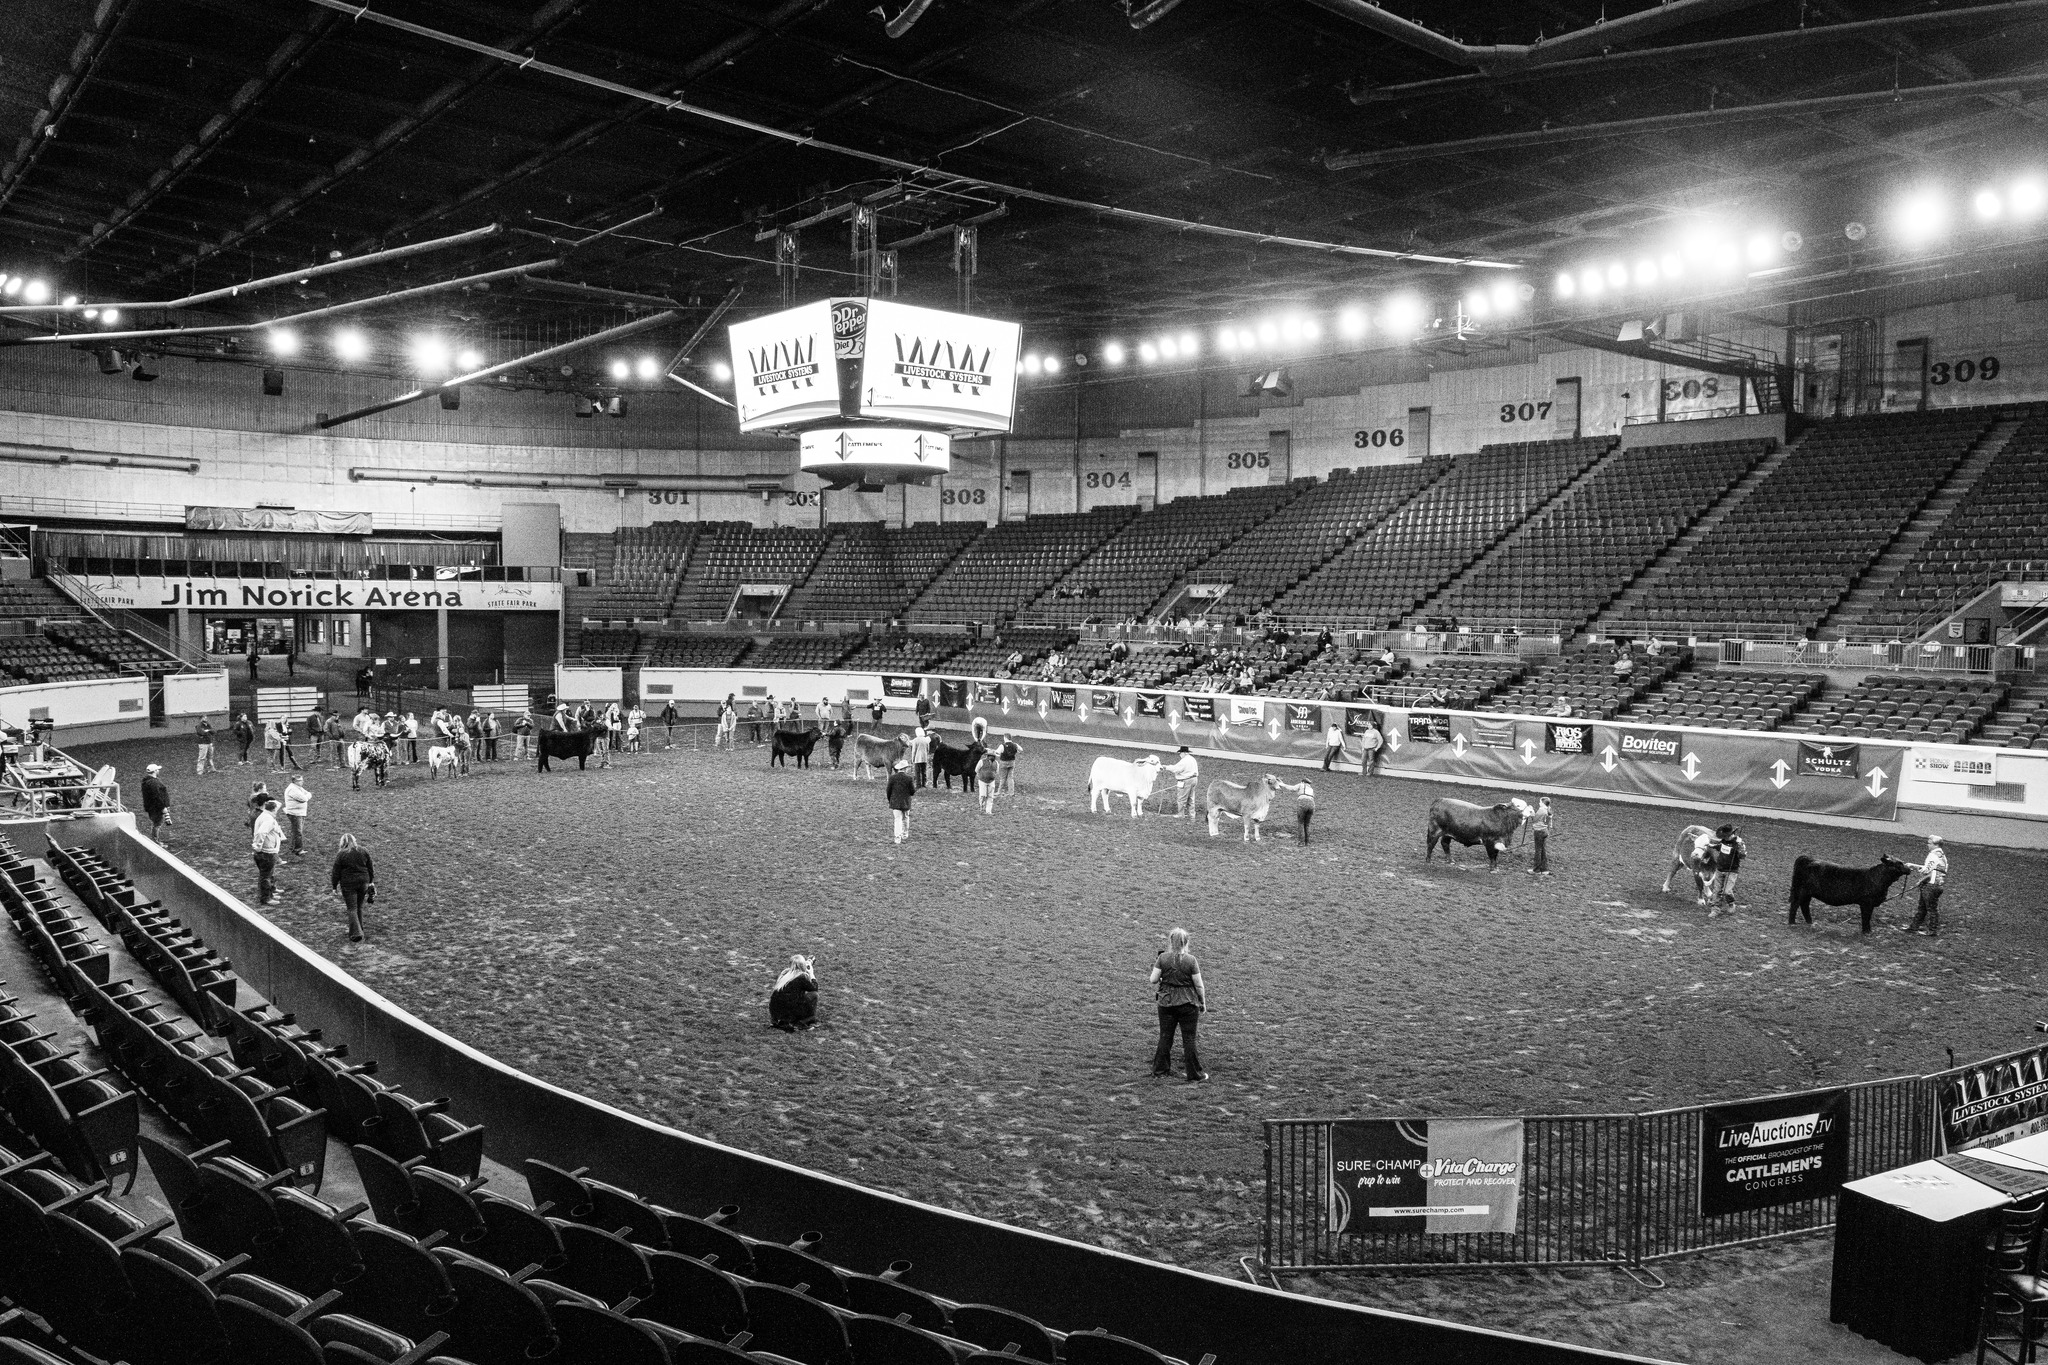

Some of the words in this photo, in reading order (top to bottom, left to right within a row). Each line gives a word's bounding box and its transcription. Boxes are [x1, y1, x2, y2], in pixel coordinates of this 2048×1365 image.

[832, 311, 866, 335] Pepper
[841, 307, 858, 322] Dr
[758, 371, 787, 384] LIVESTOCK
[787, 365, 813, 378] SYSTEMS
[903, 365, 946, 380] LIVESTOCK
[948, 371, 983, 384] SYSTEMS
[1930, 356, 2000, 385] 309
[1665, 377, 1719, 401] 308
[1501, 401, 1552, 423] 307
[1354, 428, 1405, 448] 306
[1228, 451, 1270, 469] 305
[1086, 471, 1132, 488] 304
[648, 489, 690, 505] 301
[942, 488, 986, 505] 303
[117, 597, 135, 606] PARK
[161, 582, 228, 606] Jim
[242, 583, 355, 607] Norick
[365, 586, 464, 608] Arena
[1555, 726, 1583, 740] RIOS
[1622, 735, 1677, 756] Boviteq
[1805, 757, 1852, 767] SCHULTZ
[1954, 1094, 2012, 1121] LIVESTOCK
[1725, 1157, 1737, 1165] THE
[1737, 1153, 1767, 1163] OFFICIAL
[1767, 1148, 1803, 1160] BROADCAST
[1813, 1142, 1825, 1151] THE
[1336, 1159, 1371, 1172] SURE
[1375, 1159, 1421, 1171] CHAMP
[1433, 1157, 1517, 1178] VitaCharge
[1726, 1155, 1822, 1183] CATTLEMEN'S
[1357, 1176, 1377, 1189] prep
[1376, 1173, 1385, 1186] to
[1385, 1174, 1401, 1185] win
[1434, 1178, 1464, 1187] PROTECT
[1466, 1178, 1481, 1186] AND
[1483, 1177, 1516, 1186] RECOVER
[1745, 1174, 1804, 1191] CONGRESS
[1394, 1206, 1465, 1214] www.surechamp.com
